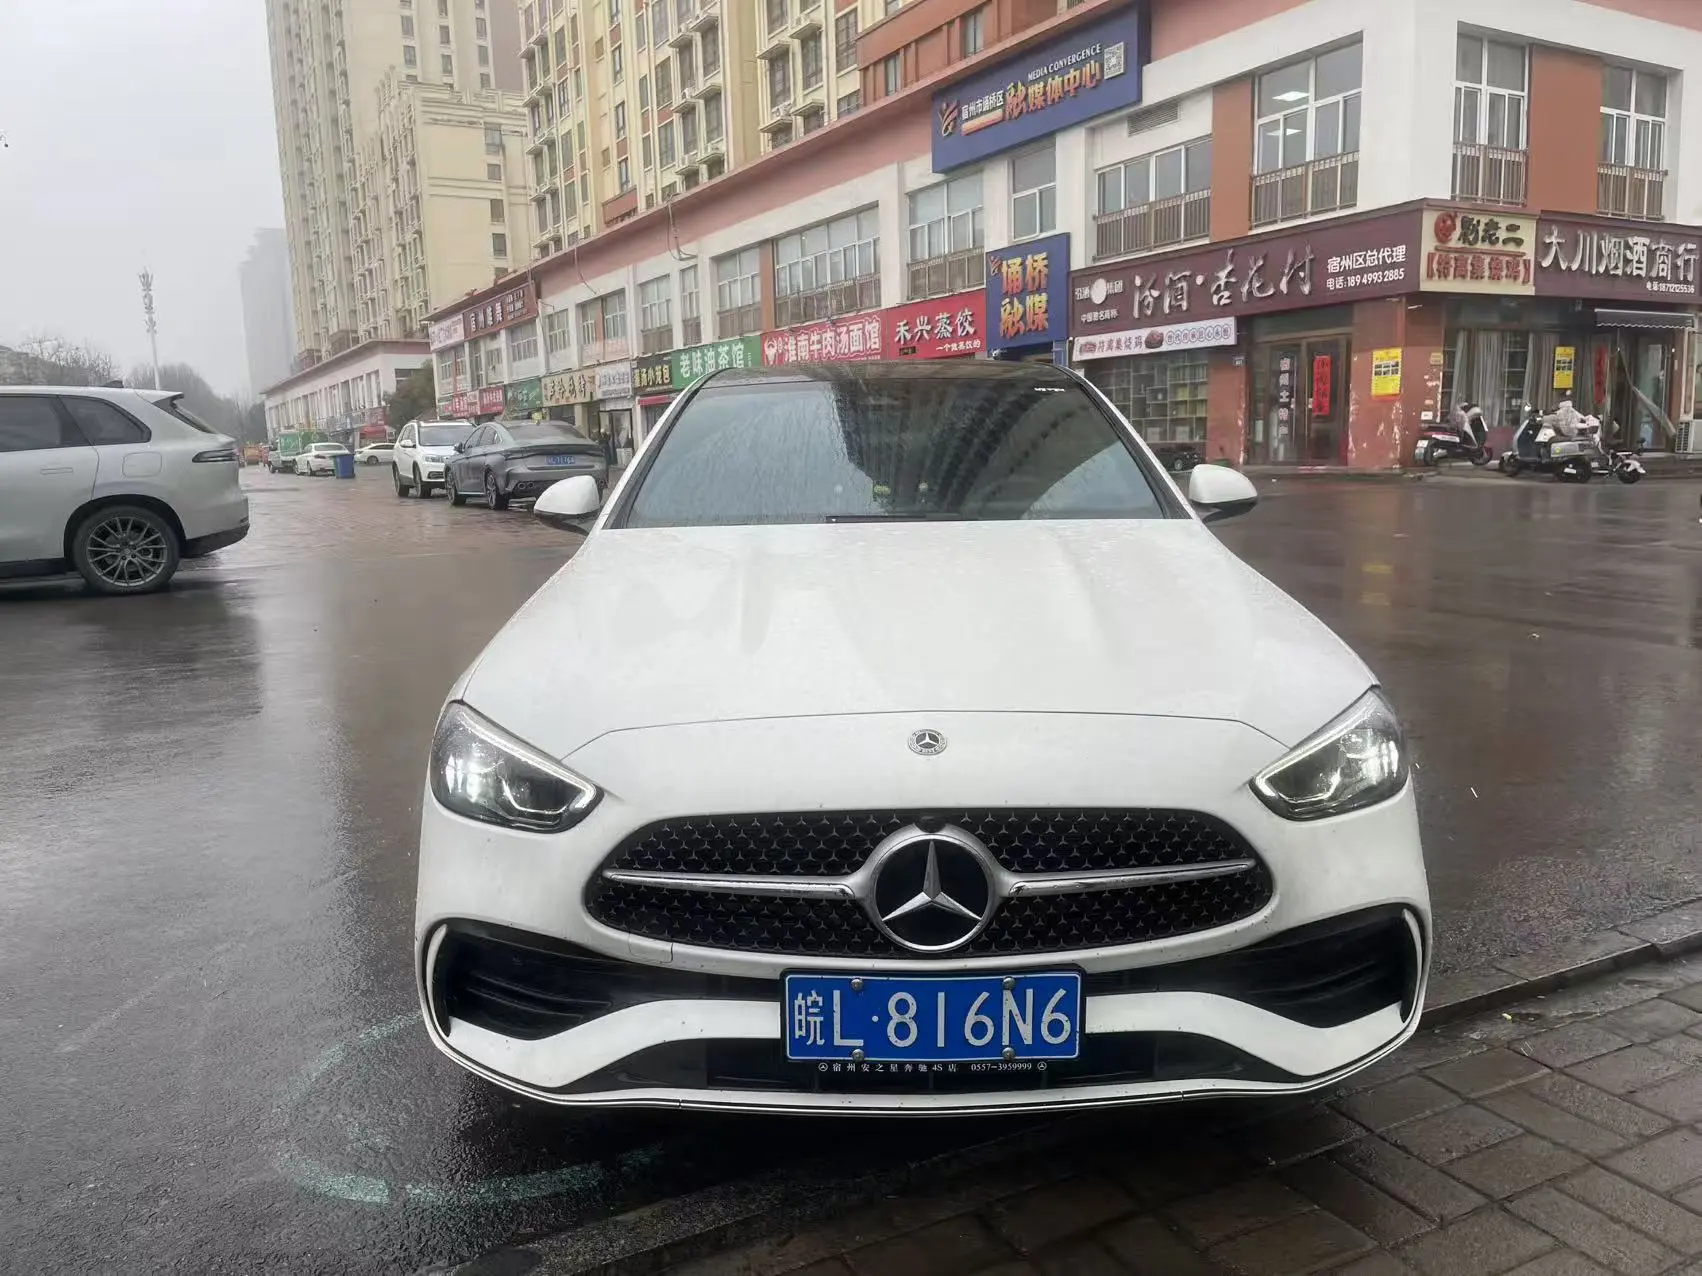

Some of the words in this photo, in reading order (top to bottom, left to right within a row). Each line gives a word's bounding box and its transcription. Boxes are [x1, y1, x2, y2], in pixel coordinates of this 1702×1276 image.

[1028, 66, 1048, 81] MEDIA
[1048, 43, 1101, 73] CONVERGENCE
[961, 91, 1004, 120] 宿州市埇桥区
[1005, 60, 1101, 120] 融媒体中心
[1327, 245, 1406, 273] 宿州区总代理
[1539, 225, 1699, 282] 大川烟酒商行
[1002, 252, 1049, 295] 埇桥
[1107, 280, 1123, 294] 集团
[895, 308, 976, 345] 禾兴蒸饺
[1000, 293, 1049, 339] 融媒
[784, 319, 881, 361] 淮南牛肉汤面馆
[680, 341, 745, 378] 老味油茶馆
[794, 988, 1072, 1048] 皖L·816N6
[971, 1062, 1032, 1072] 0557-3959999
